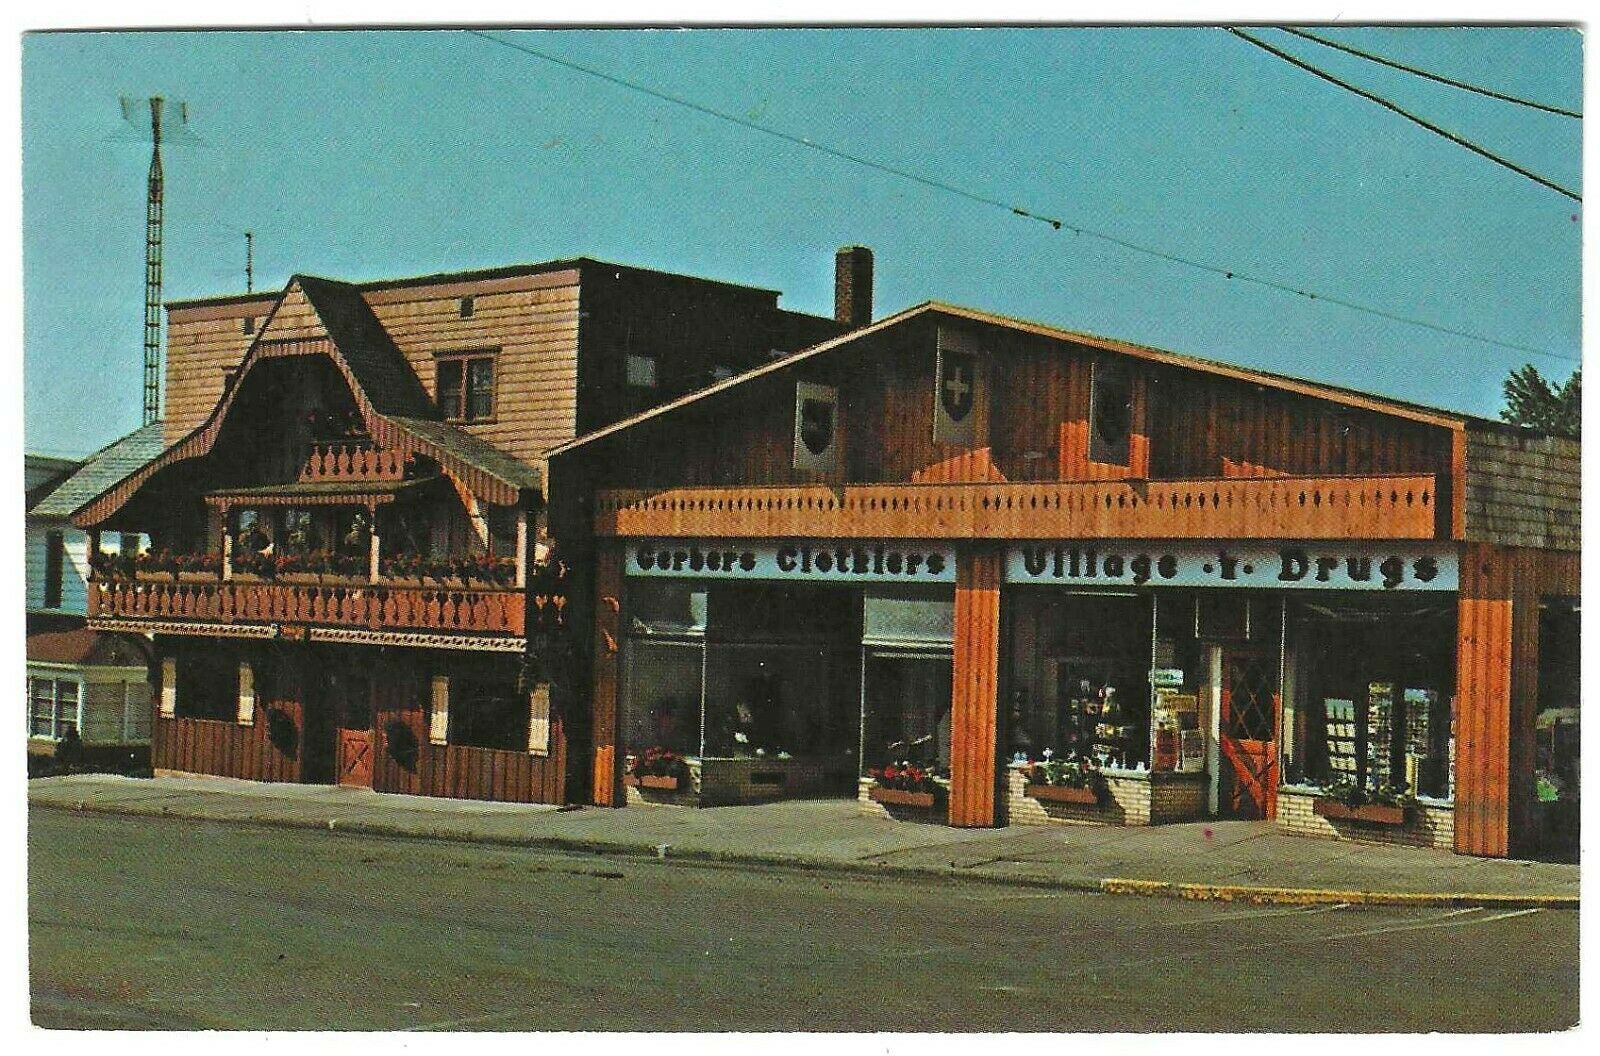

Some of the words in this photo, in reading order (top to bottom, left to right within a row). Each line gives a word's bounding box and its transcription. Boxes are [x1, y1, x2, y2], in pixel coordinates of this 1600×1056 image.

[777, 544, 946, 576] Clothiers
[1023, 544, 1178, 585] Village
[1278, 545, 1440, 589] Drugs
